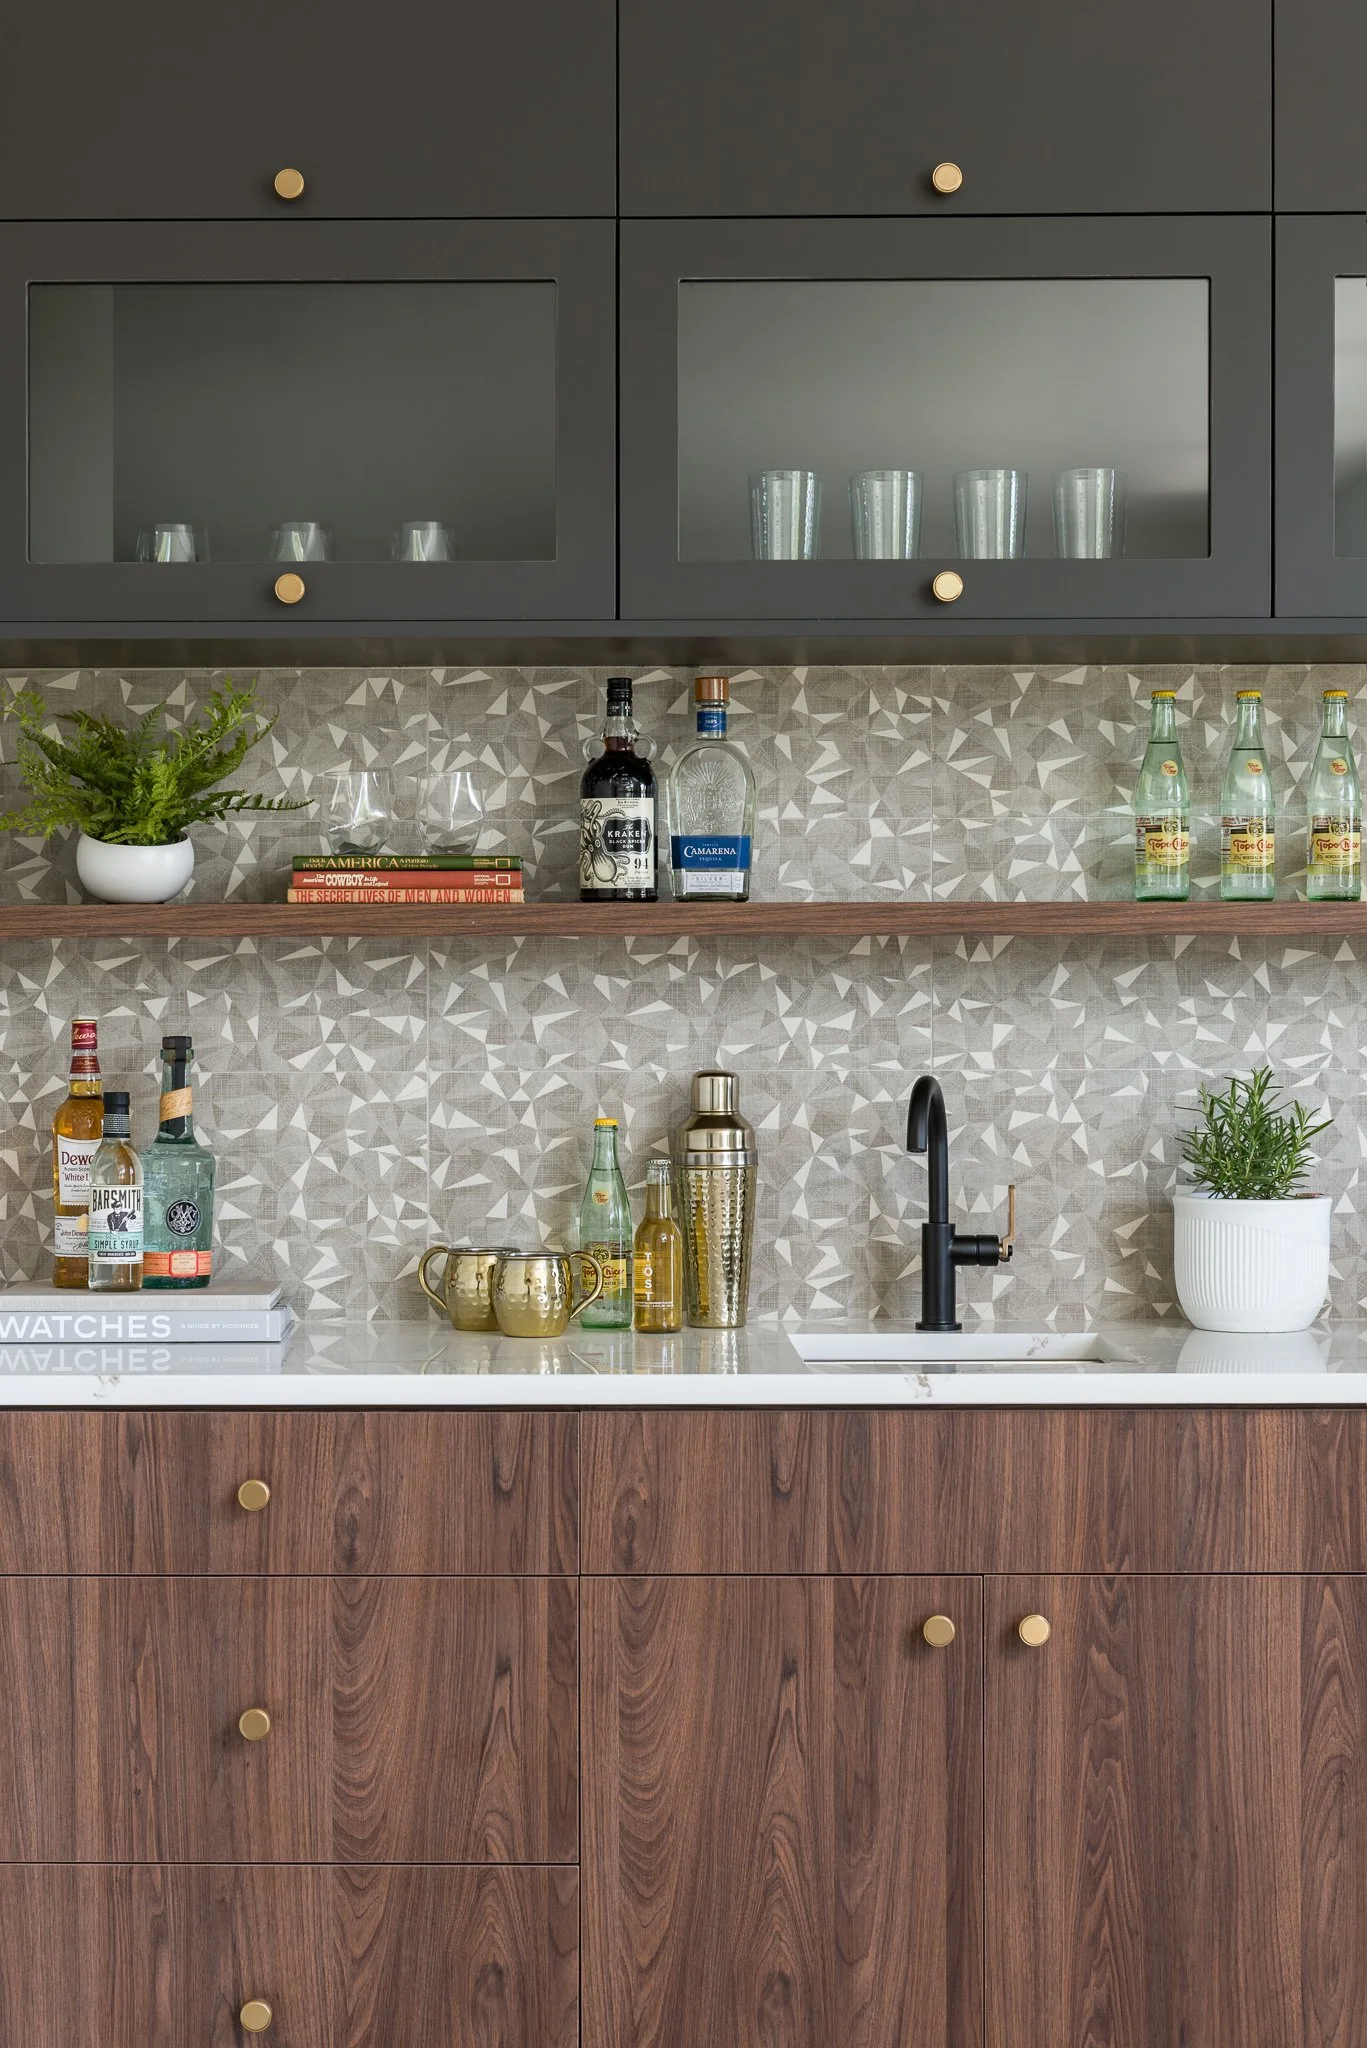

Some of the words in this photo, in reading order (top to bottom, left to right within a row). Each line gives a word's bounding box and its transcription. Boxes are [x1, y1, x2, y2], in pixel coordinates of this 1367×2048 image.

[607, 830, 647, 838] KRAKEN
[1148, 838, 1170, 850] Topo
[1233, 839, 1255, 852] Topo
[1316, 838, 1339, 851] Topo
[1340, 838, 1359, 851] Chco
[684, 846, 736, 858] CAMARENA
[325, 857, 399, 869] AMERICA
[325, 873, 364, 887] COWBOY
[295, 890, 314, 903] THE
[316, 890, 356, 903] SECRET
[359, 890, 385, 903] LIVES
[388, 890, 401, 903] OF
[405, 889, 432, 903] MEN
[436, 889, 460, 903] AND
[464, 889, 511, 903] WOMEN
[93, 1189, 141, 1212] BARSMITH
[94, 1240, 117, 1250] SIMPLE
[581, 1265, 597, 1278] Top
[602, 1265, 625, 1279] Chico
[0, 1315, 171, 1339] WATCHES
